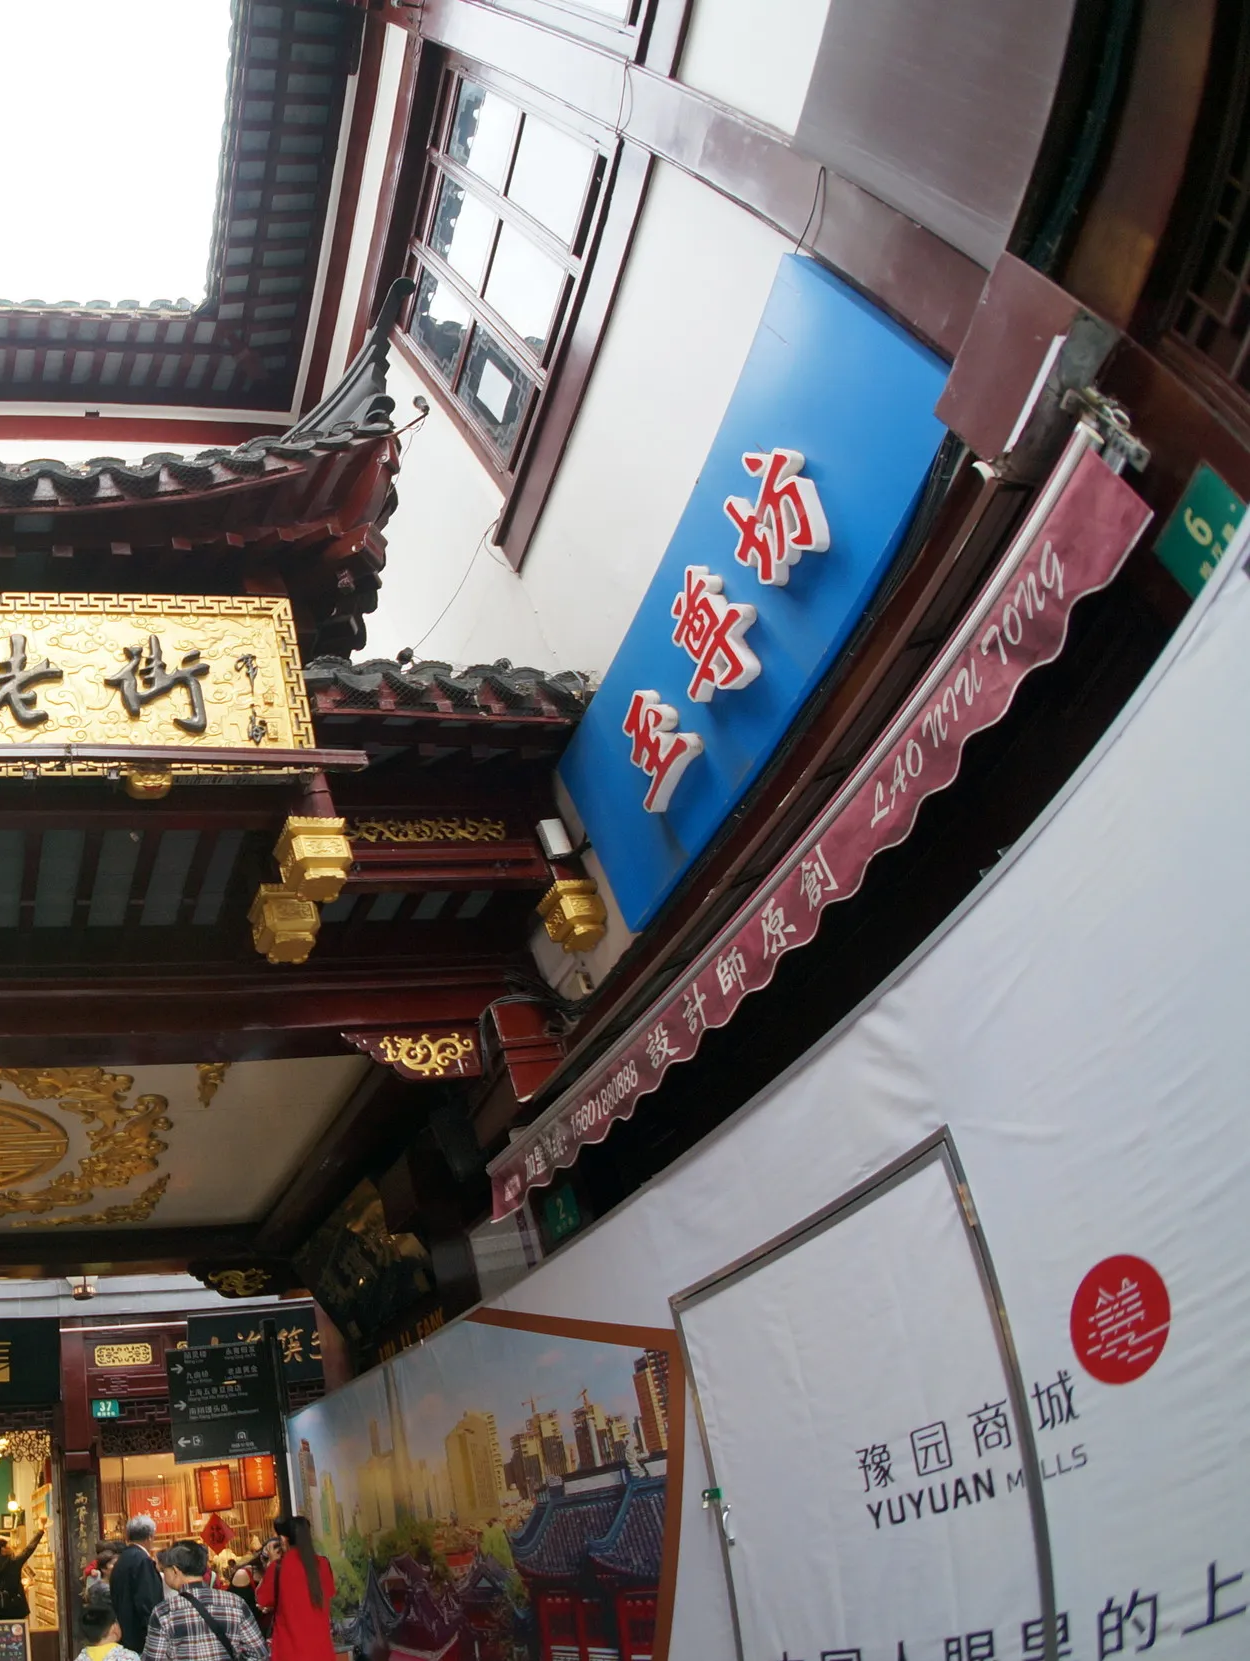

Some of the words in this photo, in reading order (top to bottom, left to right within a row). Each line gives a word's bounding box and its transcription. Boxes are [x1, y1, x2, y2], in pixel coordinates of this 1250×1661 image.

[1184, 507, 1213, 546] 6
[622, 446, 830, 814] 至尊坊
[570, 1059, 638, 1141] 15601880888
[646, 844, 839, 1069] 設計師原創
[870, 738, 923, 829] LAO
[921, 658, 983, 749] NIU
[980, 540, 1065, 666] TONG
[99, 1400, 112, 1412] 37
[855, 1369, 1081, 1494] 豫园商城
[867, 1468, 996, 1530] YUYUAN
[1006, 1443, 1089, 1494] MLLS
